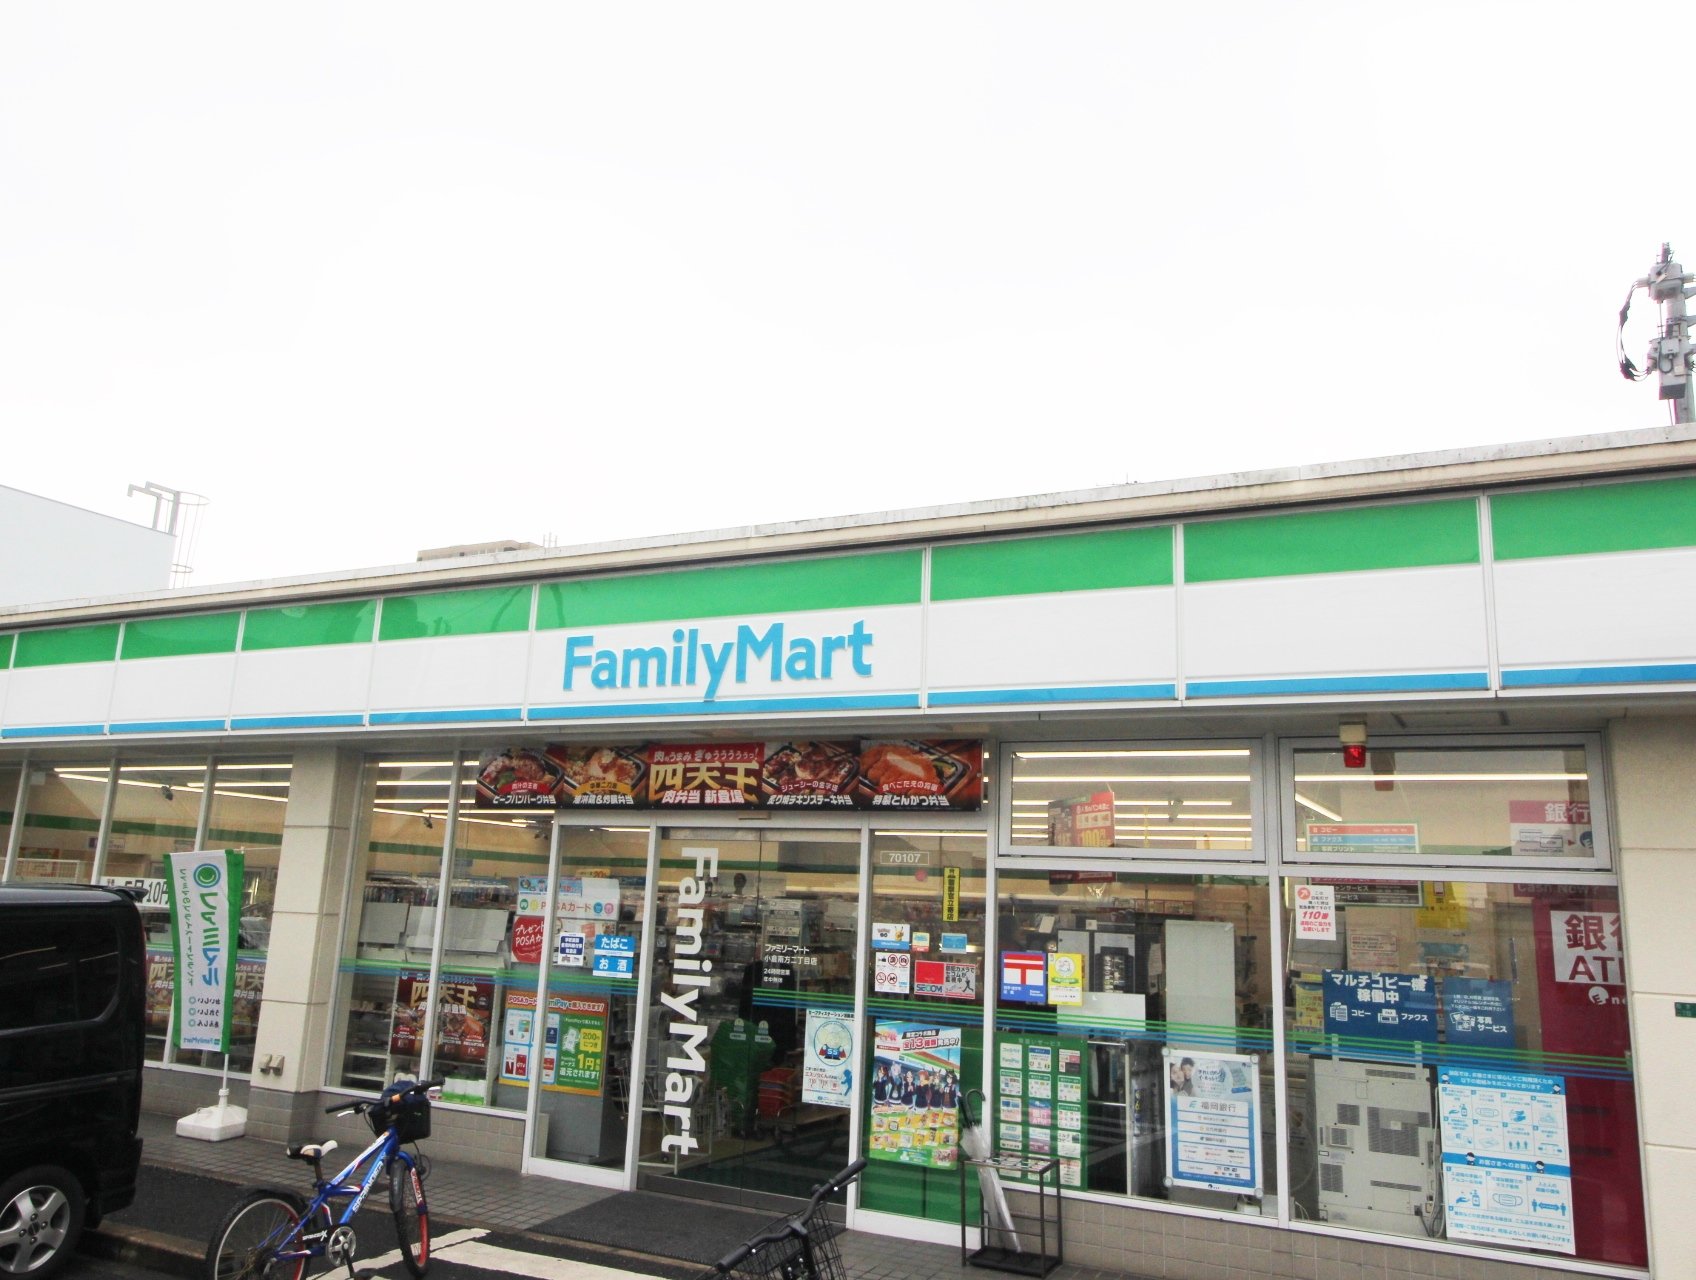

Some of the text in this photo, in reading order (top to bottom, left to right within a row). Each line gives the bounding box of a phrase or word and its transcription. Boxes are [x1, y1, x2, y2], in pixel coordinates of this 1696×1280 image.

[563, 619, 873, 702] FamilyMart
[648, 761, 760, 804] 四天王
[661, 789, 745, 804] 肉弁当 新登場
[889, 853, 921, 863] 70107
[601, 936, 628, 949] たばこ
[764, 944, 809, 954] ファミリーマート
[599, 959, 627, 971] お酒
[1331, 973, 1428, 992] マルチコピー機
[660, 847, 719, 1156] FamilyMart
[1351, 1009, 1371, 1017] コピー
[1401, 1013, 1429, 1022] ファクス
[1477, 1024, 1507, 1033] サービス
